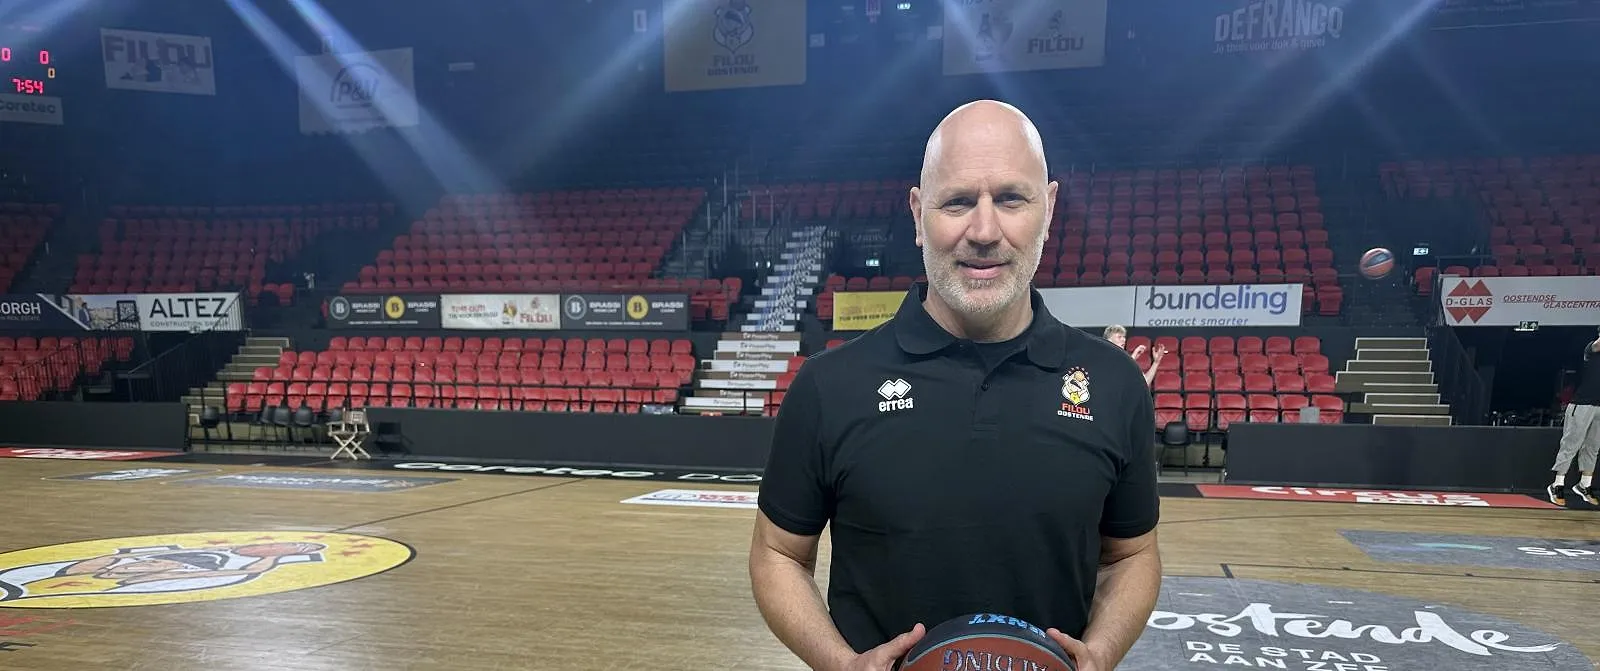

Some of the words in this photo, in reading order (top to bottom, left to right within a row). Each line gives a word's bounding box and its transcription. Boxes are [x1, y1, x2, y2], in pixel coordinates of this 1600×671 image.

[1026, 35, 1085, 54] FILOU
[1, 47, 11, 62] 0
[39, 50, 49, 65] 0
[103, 36, 211, 69] FILOU
[47, 67, 56, 79] 0
[12, 78, 44, 94] 7:54
[1145, 285, 1288, 315] bundeling
[1446, 297, 1493, 306] D-GLAS
[1503, 295, 1557, 303] OOSTENDSE
[0, 302, 41, 315] ORGH
[149, 298, 229, 318] ALTEZ
[1148, 317, 1197, 326] connect
[1200, 316, 1248, 326] smarter
[1057, 410, 1094, 421] OOSTENDE
[1062, 402, 1090, 414] FILOU
[1517, 546, 1600, 557] SP
[1146, 602, 1562, 656] ostende
[1186, 640, 1245, 654] DE
[1260, 646, 1382, 664] STAD
[1189, 652, 1288, 669] AAN
